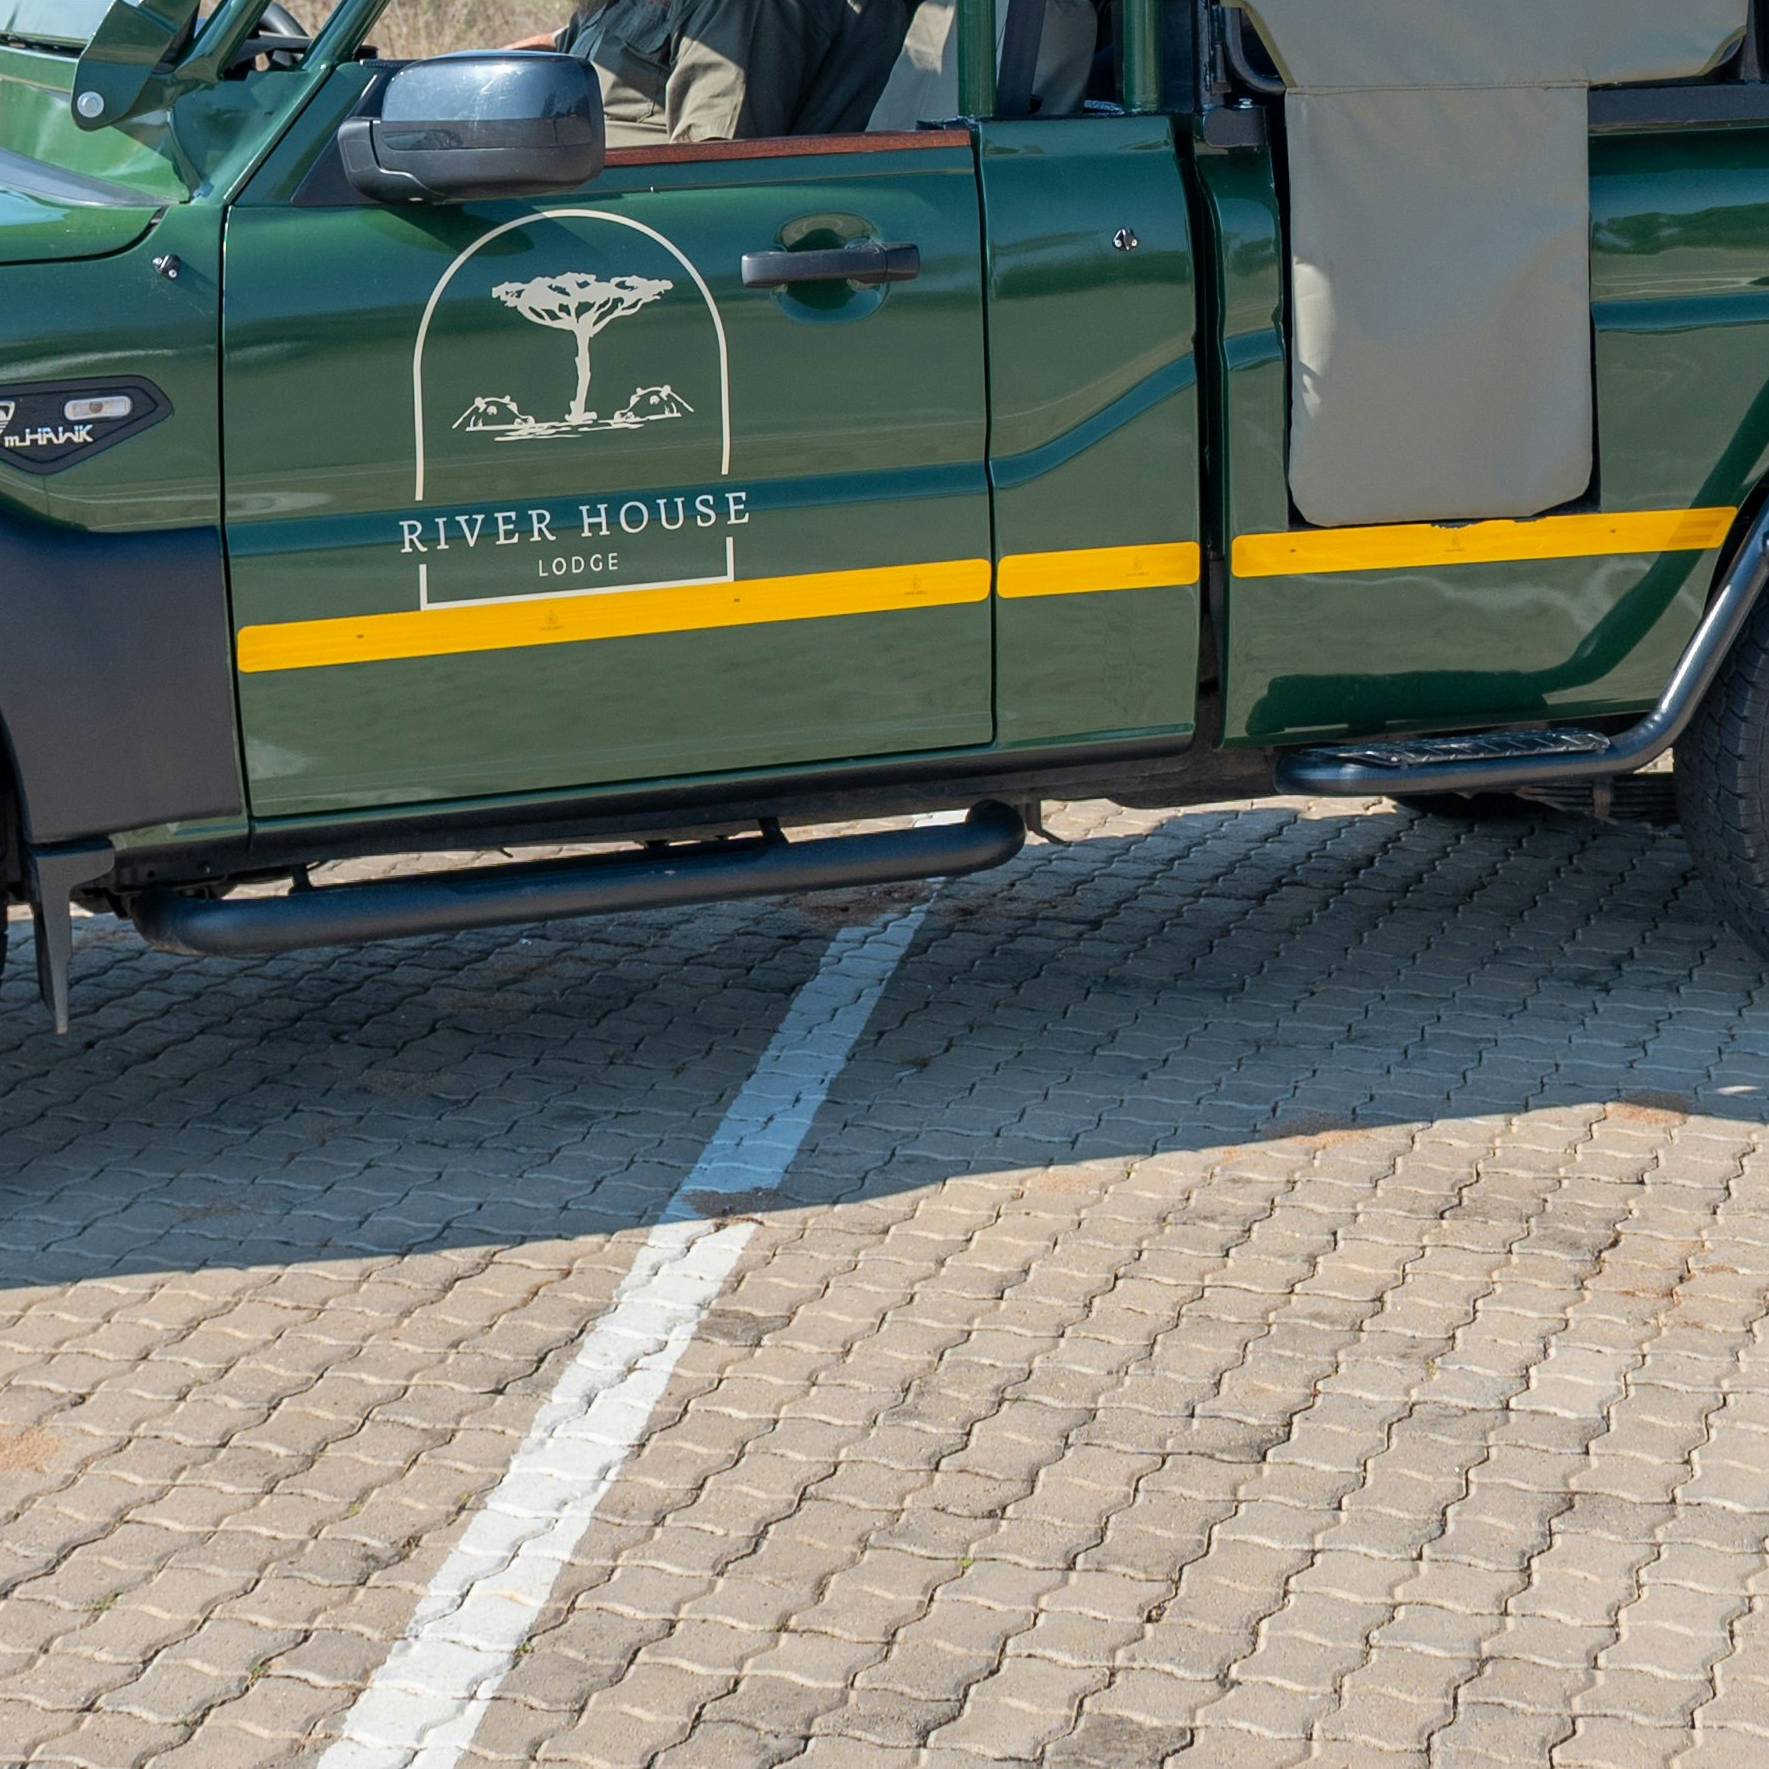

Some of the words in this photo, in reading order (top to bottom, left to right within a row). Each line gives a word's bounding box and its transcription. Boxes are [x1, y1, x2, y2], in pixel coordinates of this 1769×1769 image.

[399, 509, 556, 554] RIVER
[579, 491, 750, 538] HOUSE
[538, 552, 619, 577] LODGE
